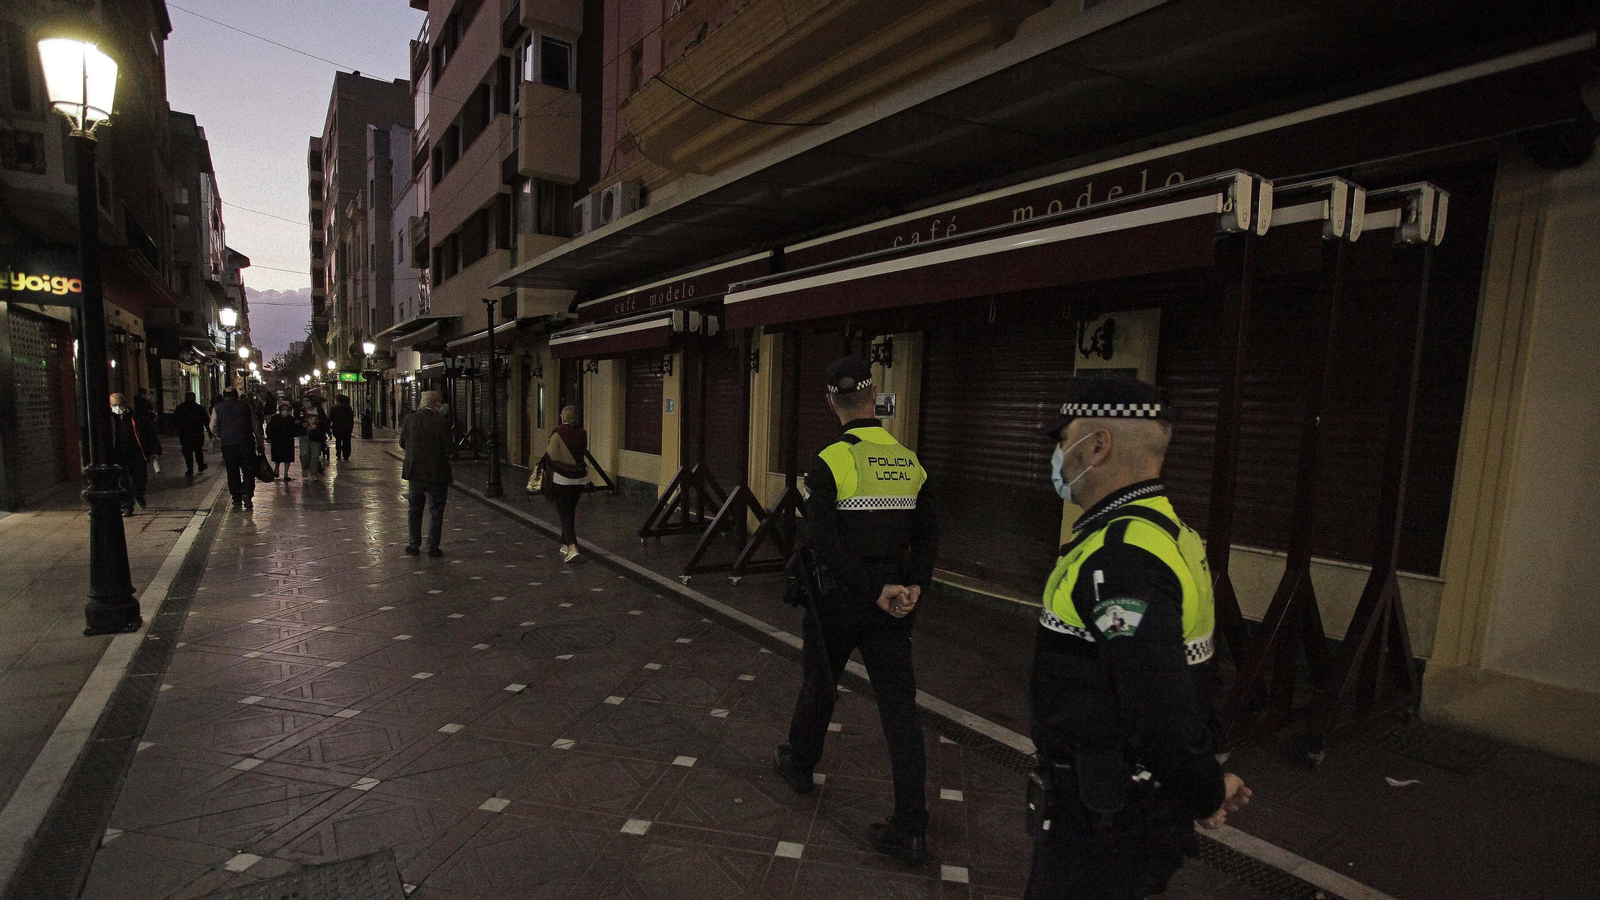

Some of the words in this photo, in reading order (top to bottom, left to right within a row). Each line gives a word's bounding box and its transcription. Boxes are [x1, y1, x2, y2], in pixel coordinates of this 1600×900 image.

[893, 215, 957, 248] café
[1012, 168, 1186, 222] modelo
[10, 272, 82, 295] yoigo
[614, 296, 636, 314] café
[649, 282, 695, 306] modelo
[868, 456, 915, 468] POLICIA
[875, 471, 911, 481] LOCAL
